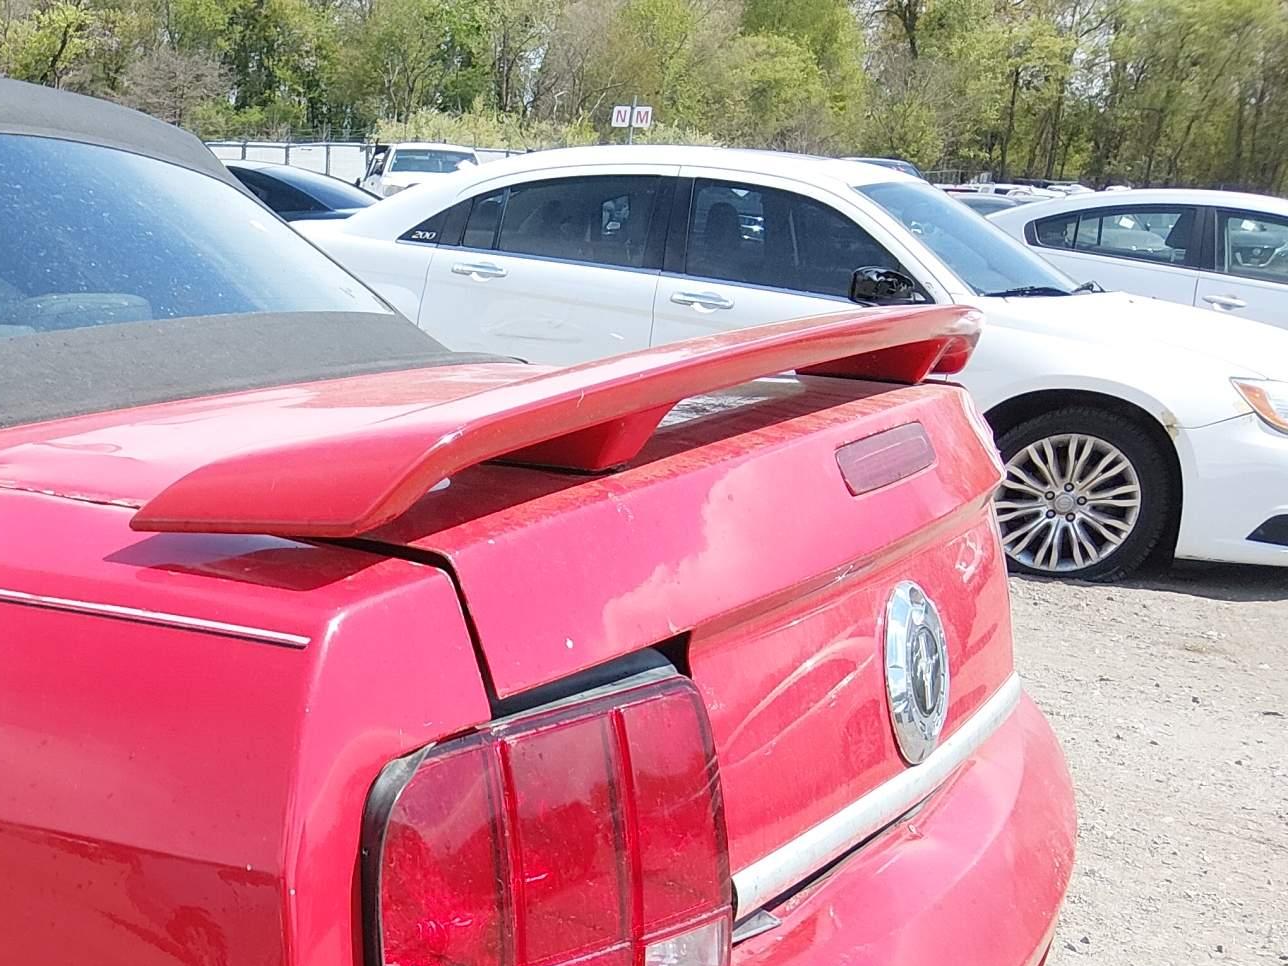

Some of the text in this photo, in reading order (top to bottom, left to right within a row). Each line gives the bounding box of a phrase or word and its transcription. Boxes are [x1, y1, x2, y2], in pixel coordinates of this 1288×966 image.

[615, 109, 649, 124] N M
[411, 230, 437, 240] 200
